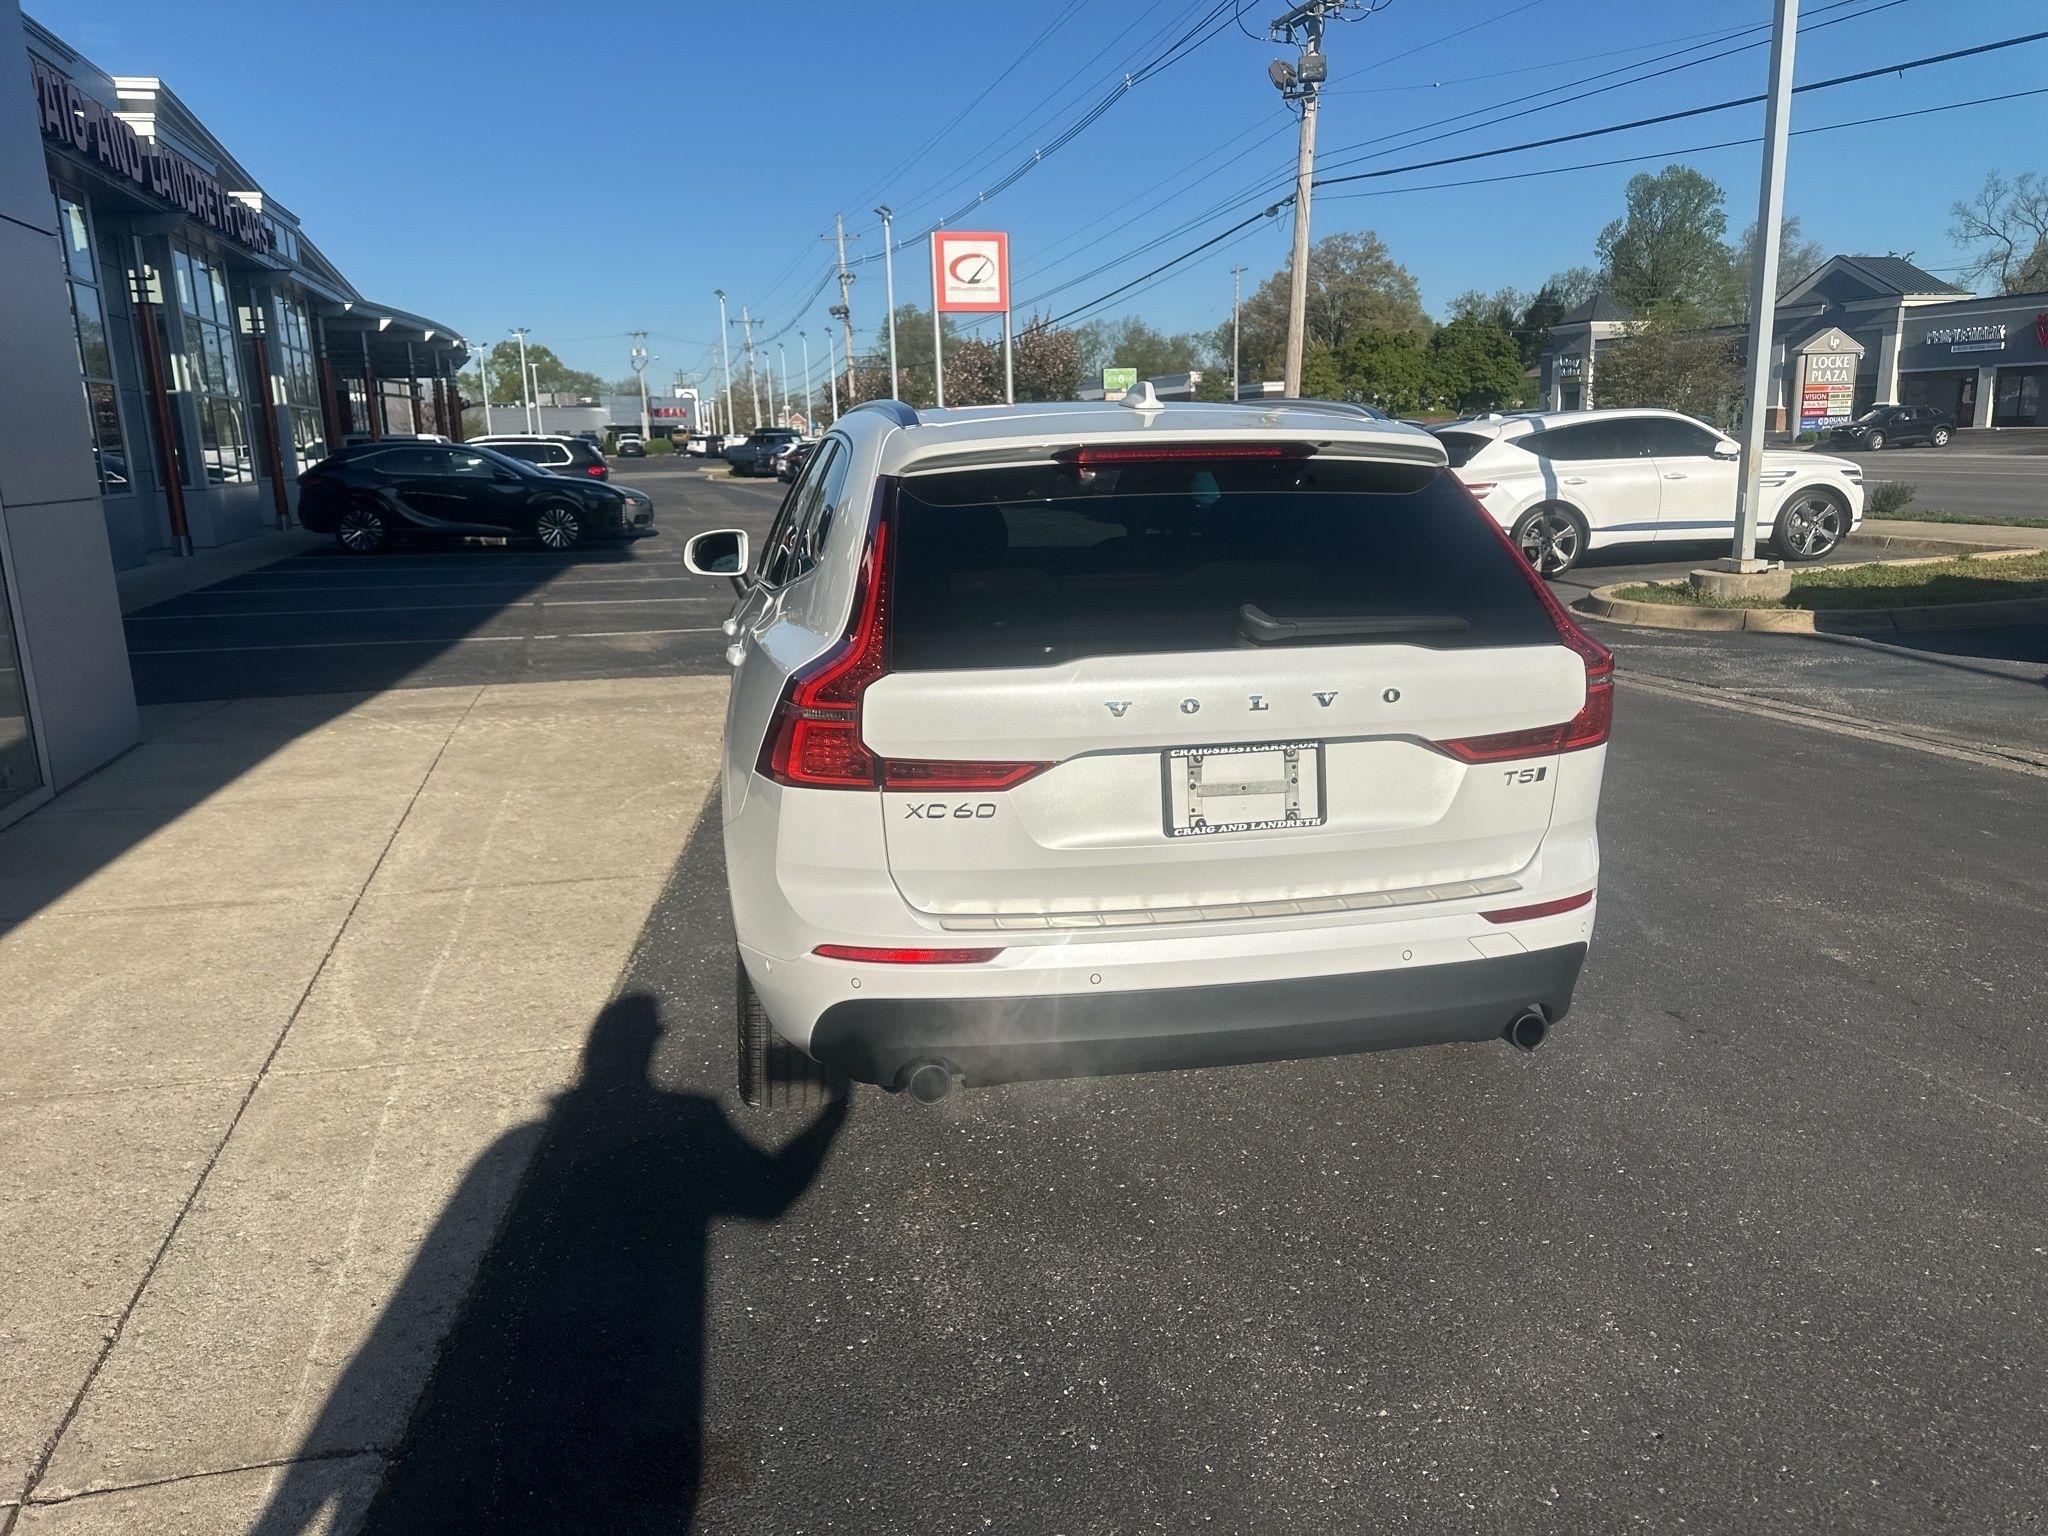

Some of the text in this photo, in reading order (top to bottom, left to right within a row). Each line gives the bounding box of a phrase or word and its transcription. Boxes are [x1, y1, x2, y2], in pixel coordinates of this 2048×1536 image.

[96, 101, 143, 183] AND
[148, 146, 235, 236] LANDRETH
[235, 196, 269, 254] CARS
[1812, 356, 1850, 369] LOCKE
[1811, 369, 1848, 382] PLAZA
[1104, 687, 1402, 718] VOLVO
[1503, 768, 1535, 786] T5
[1173, 818, 1322, 836] CRAIG AND LANDRETH
